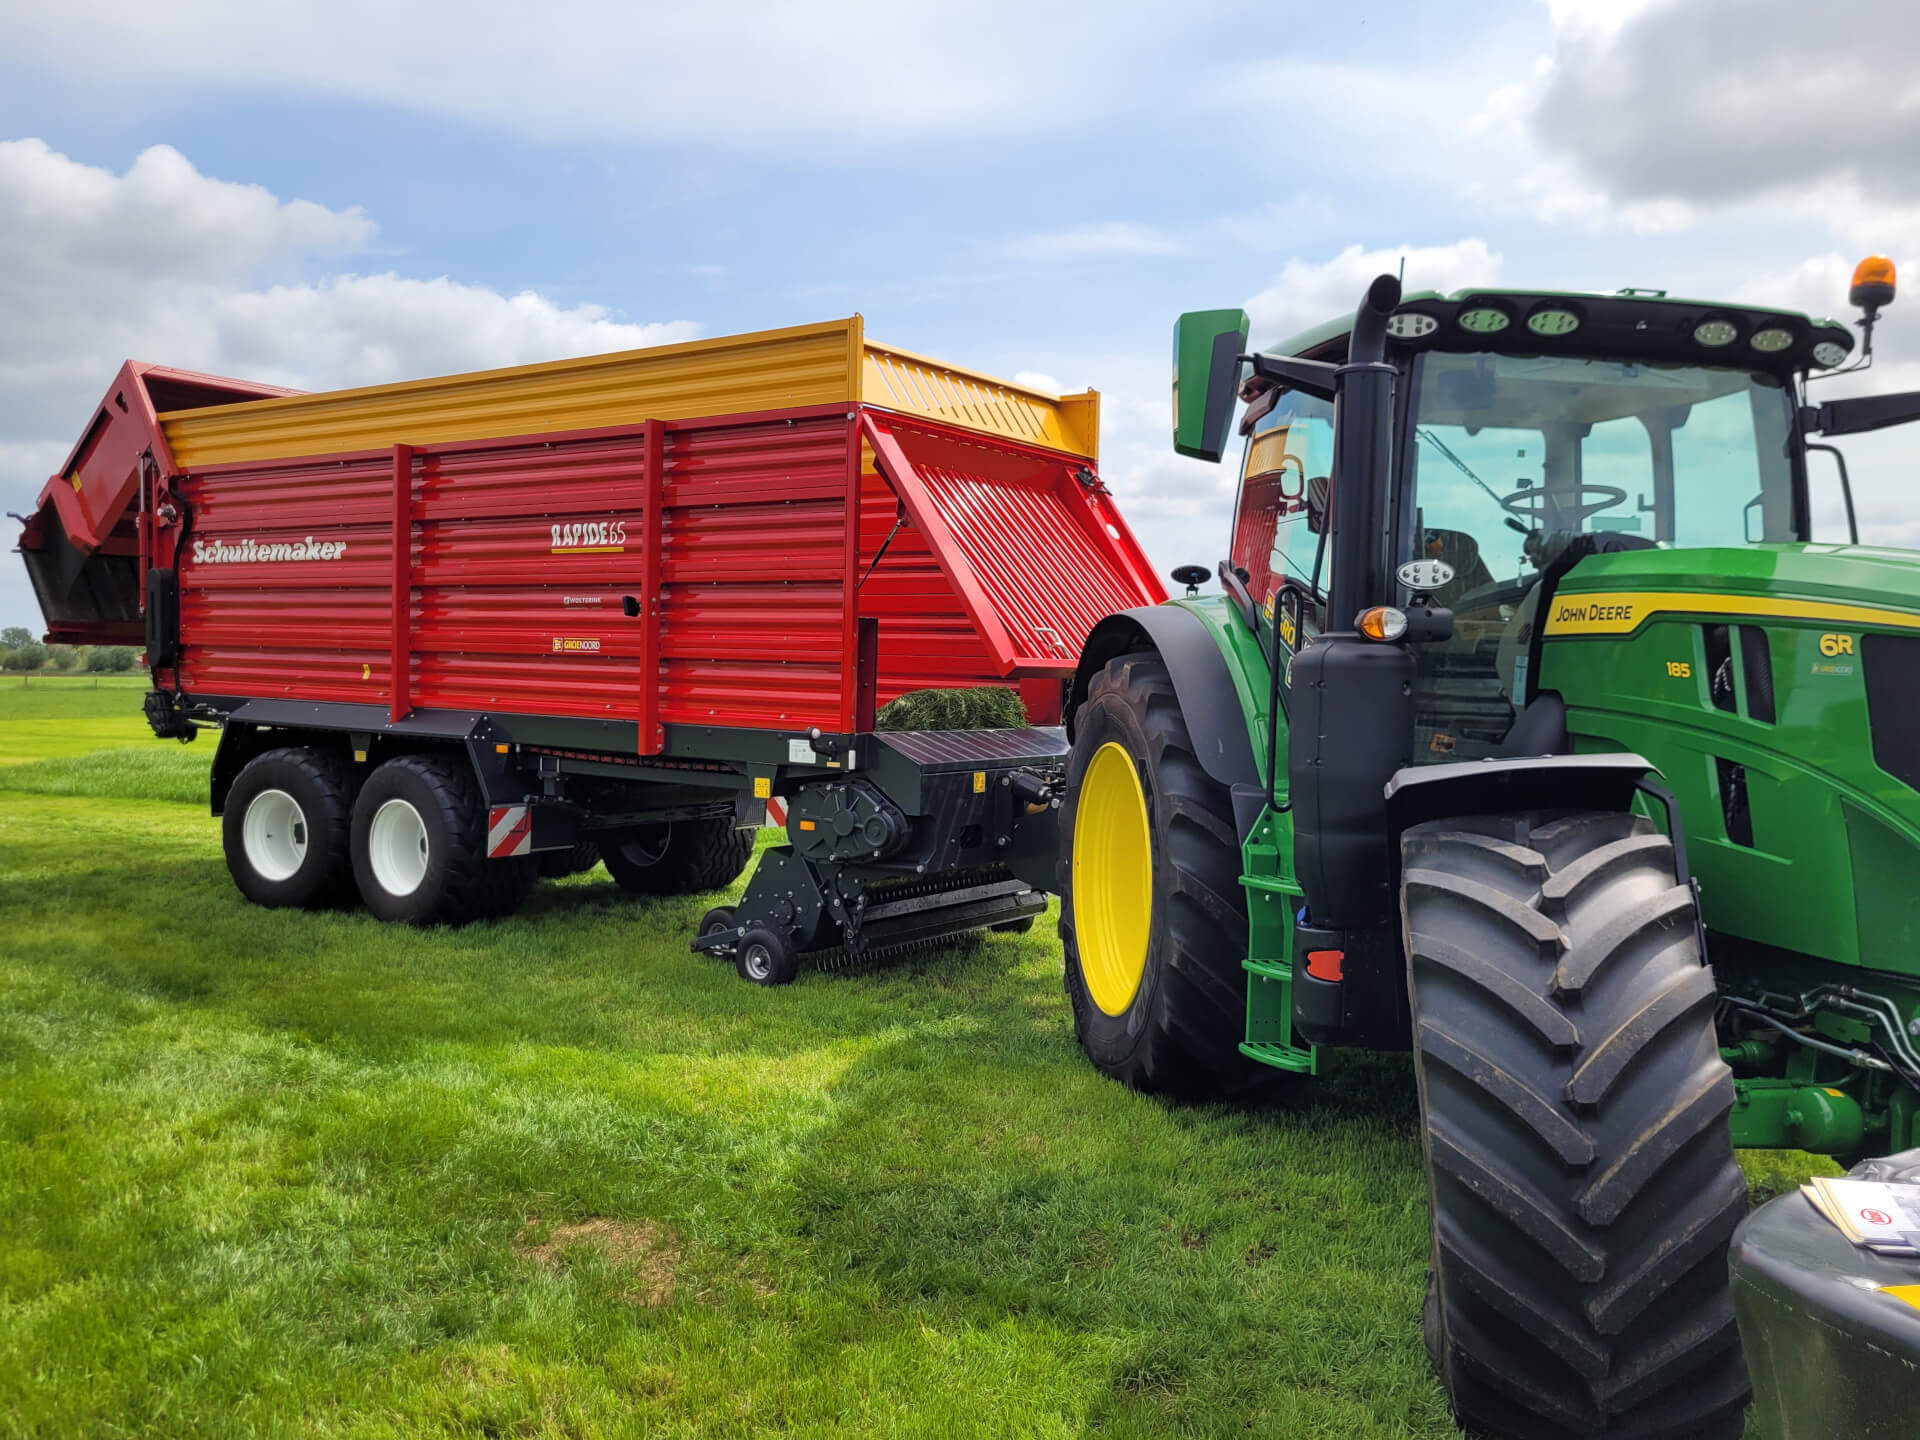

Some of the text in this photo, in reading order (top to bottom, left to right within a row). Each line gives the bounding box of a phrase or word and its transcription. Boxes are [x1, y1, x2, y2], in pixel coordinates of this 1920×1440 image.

[192, 536, 347, 564] Schuitemaker
[1556, 604, 1633, 622] JOHN DEERE
[1819, 633, 1854, 657] 6R
[1666, 661, 1691, 678] 185
